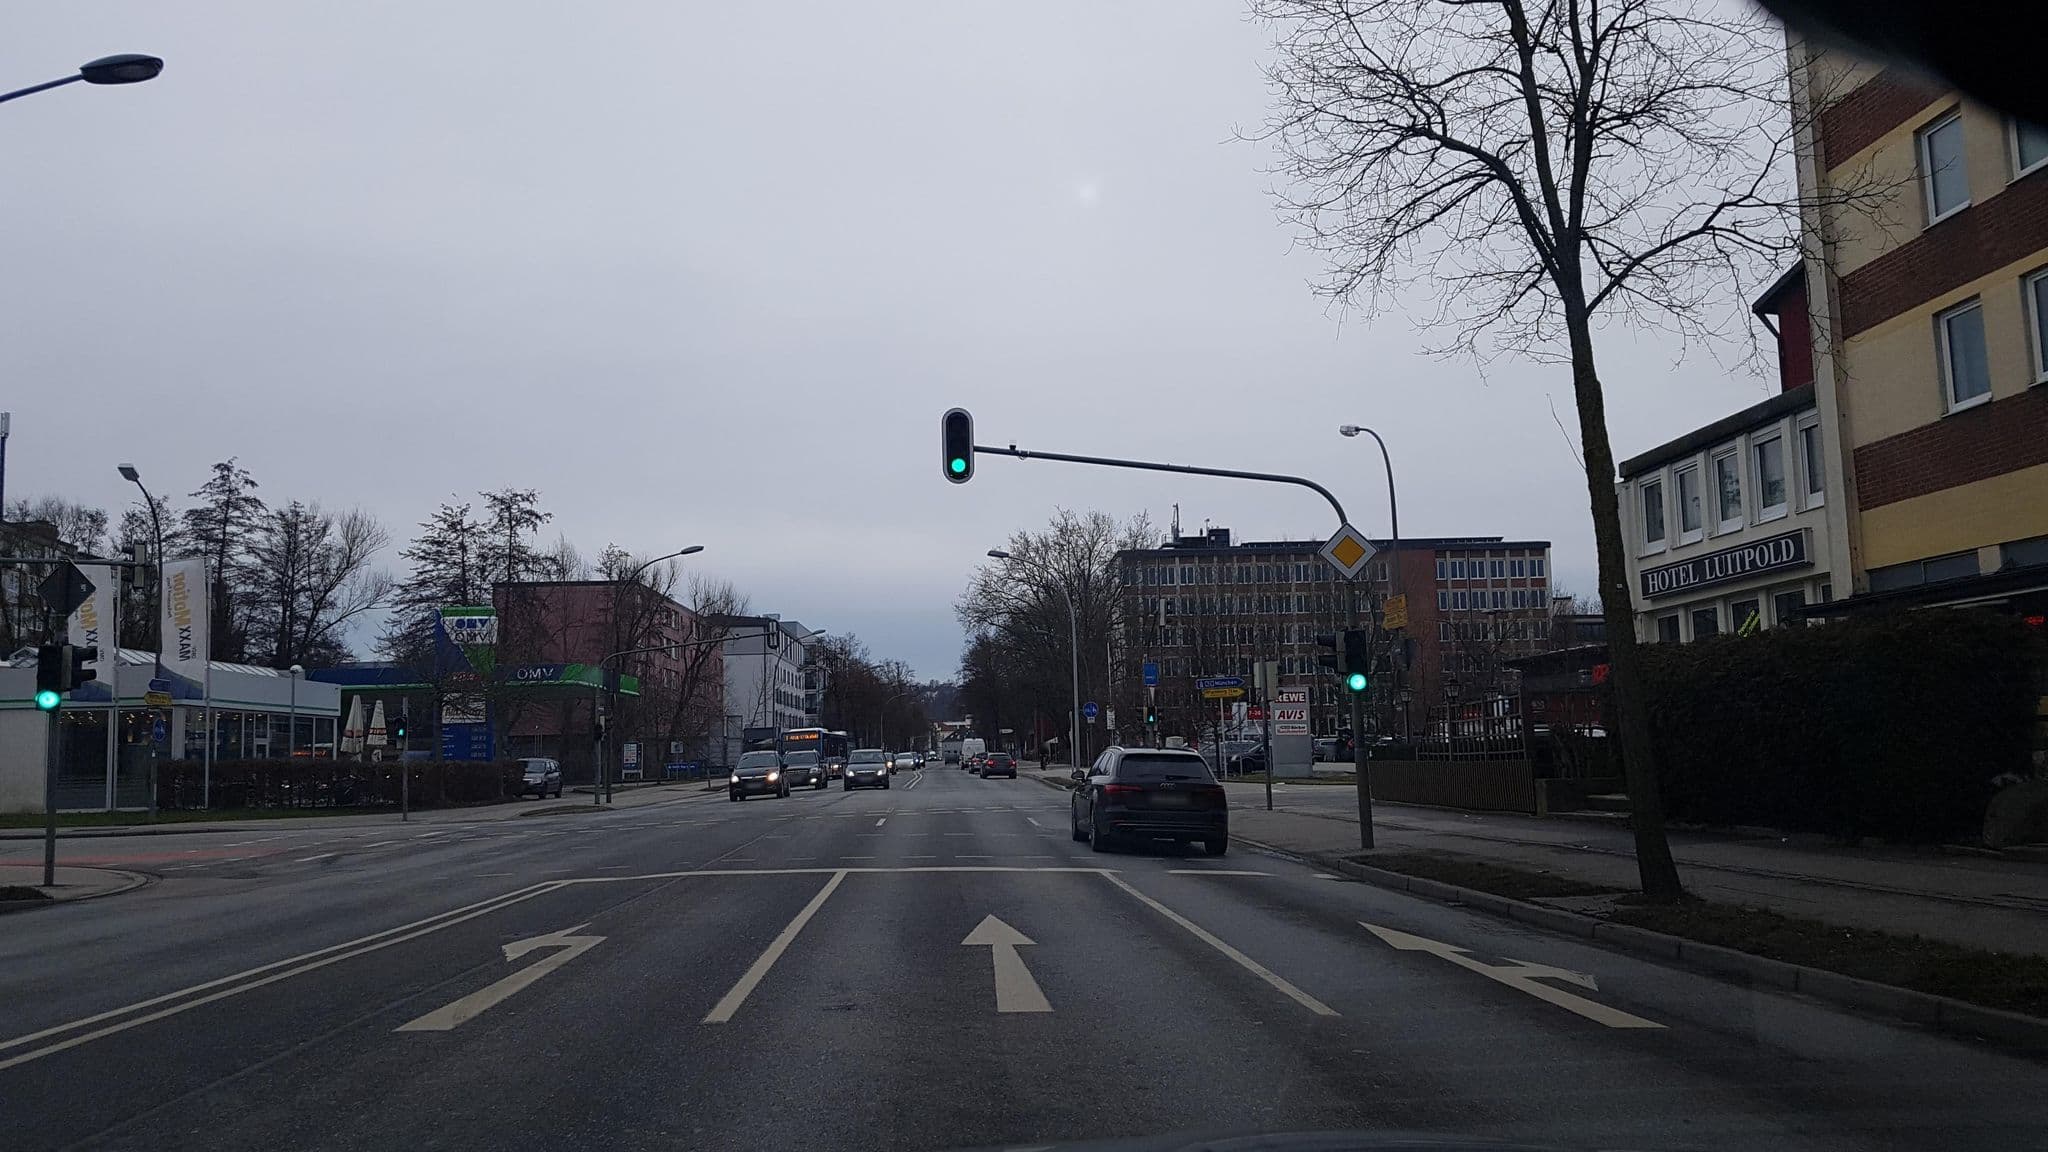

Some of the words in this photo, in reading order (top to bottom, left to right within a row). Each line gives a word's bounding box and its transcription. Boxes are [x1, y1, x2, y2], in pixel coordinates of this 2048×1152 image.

[1648, 563, 1699, 593] HOTEL
[1704, 538, 1795, 580] LUITPOLD
[454, 632, 488, 642] OMV
[517, 667, 553, 680] OMV
[1277, 710, 1304, 720] AVIS
